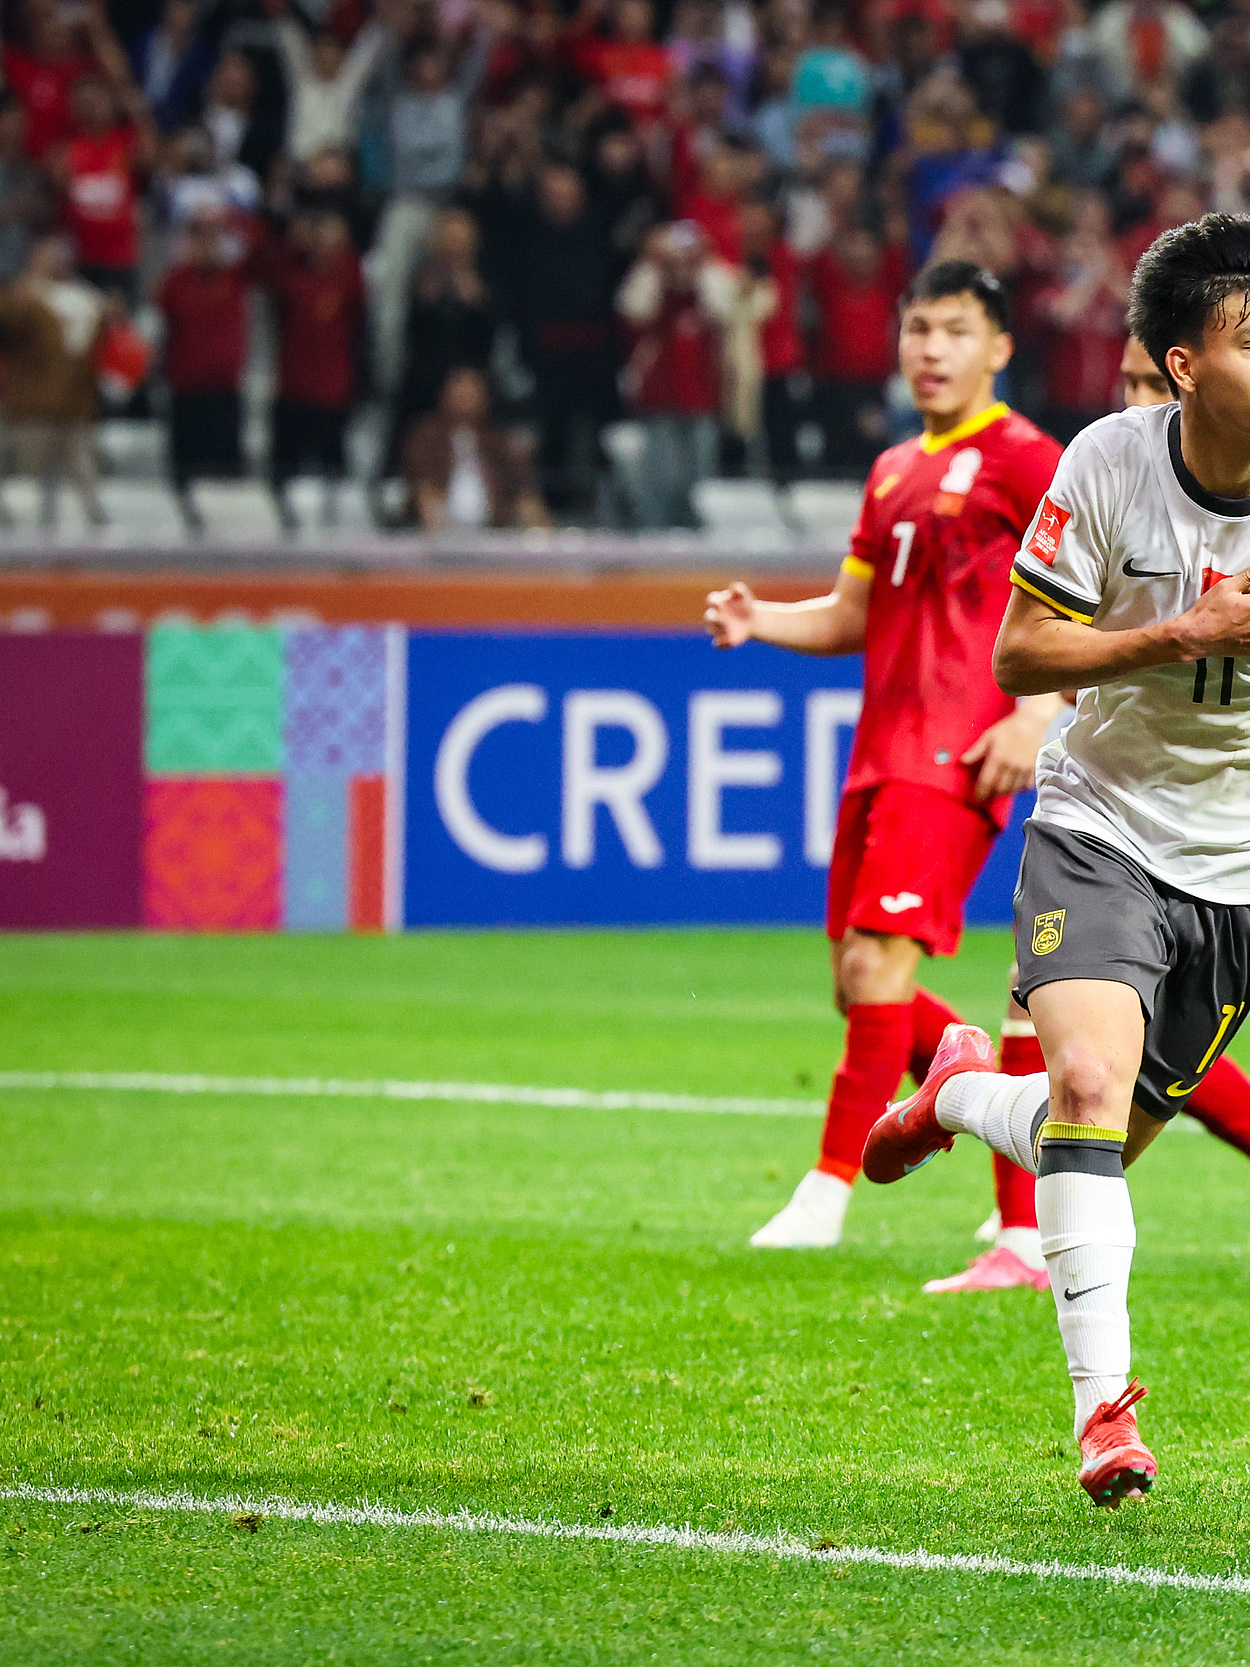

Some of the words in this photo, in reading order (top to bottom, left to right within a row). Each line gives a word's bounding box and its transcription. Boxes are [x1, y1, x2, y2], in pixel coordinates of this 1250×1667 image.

[891, 521, 917, 587] 7
[1192, 656, 1234, 706] 11
[1195, 1001, 1246, 1074] 1
